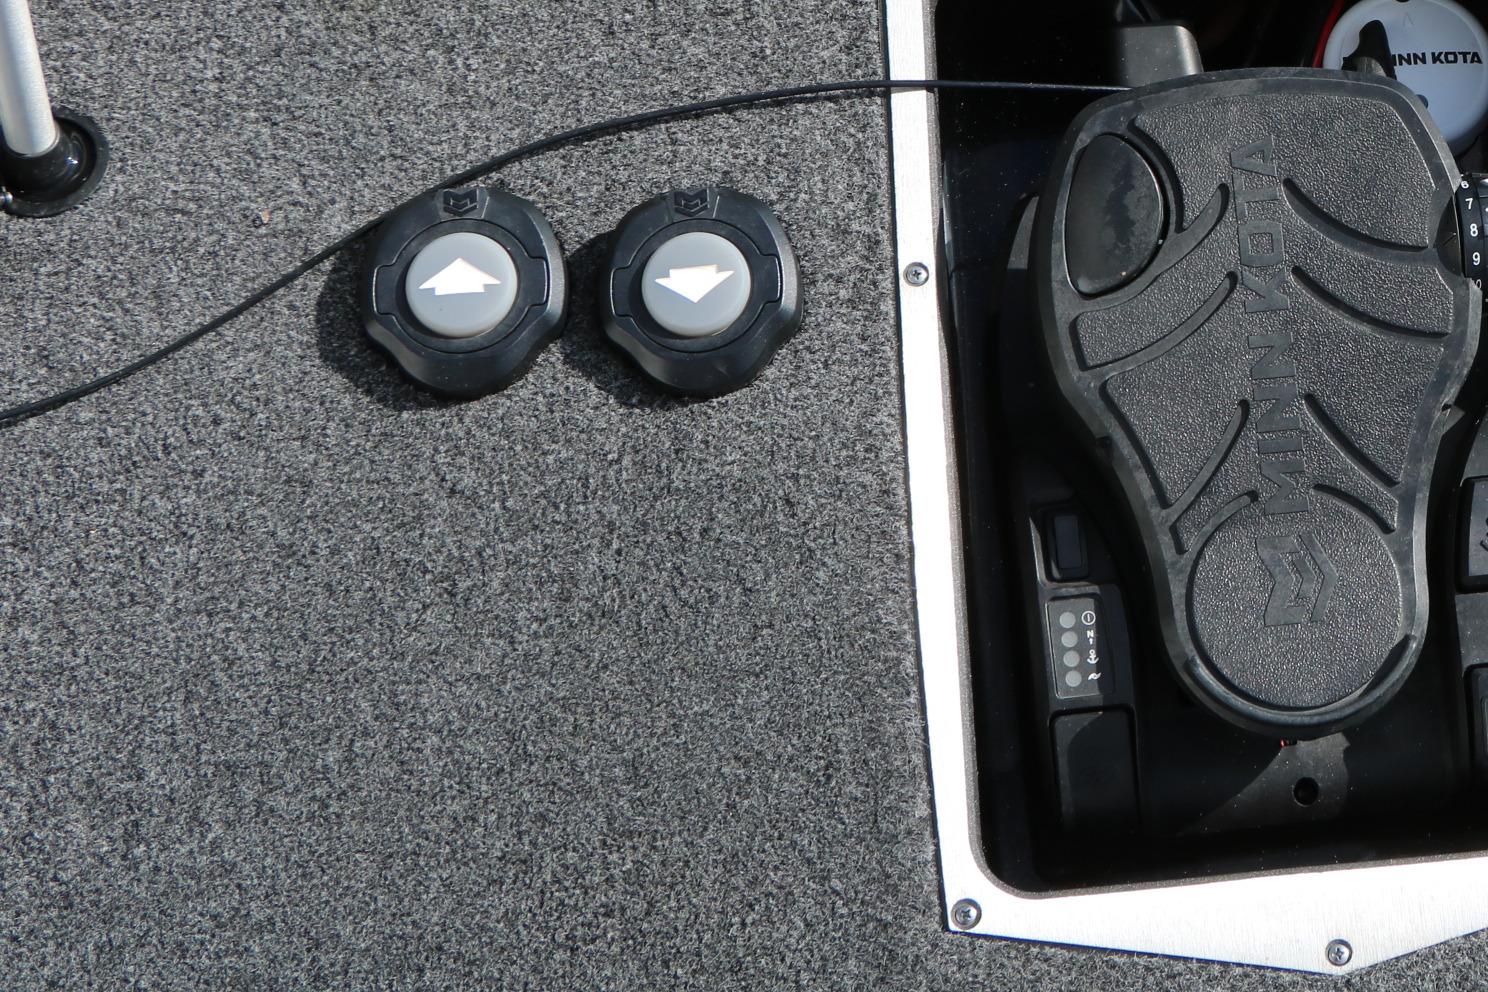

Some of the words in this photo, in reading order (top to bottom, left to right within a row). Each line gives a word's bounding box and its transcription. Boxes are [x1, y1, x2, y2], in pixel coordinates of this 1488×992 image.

[1391, 52, 1427, 67] INN
[1431, 51, 1483, 65] KOTA
[1465, 197, 1474, 210] 7
[1229, 133, 1291, 314] KOTA
[1469, 223, 1479, 237] 8
[1472, 251, 1481, 266] 9
[1247, 331, 1310, 516] MINN
